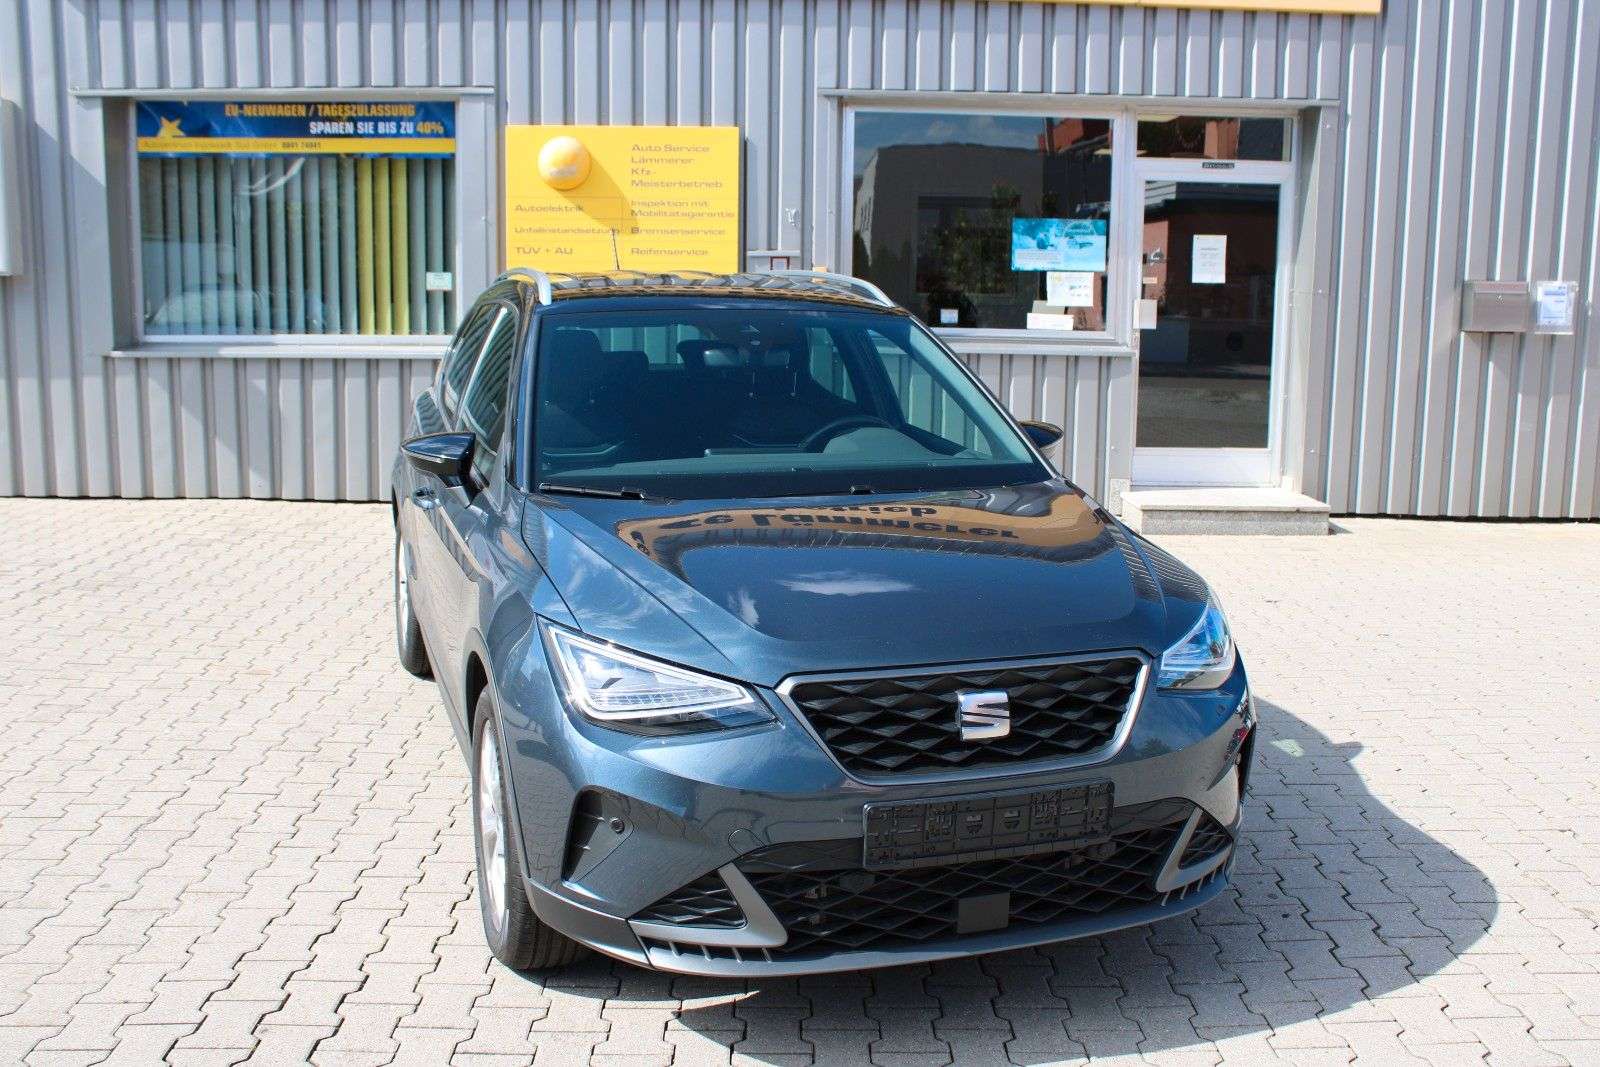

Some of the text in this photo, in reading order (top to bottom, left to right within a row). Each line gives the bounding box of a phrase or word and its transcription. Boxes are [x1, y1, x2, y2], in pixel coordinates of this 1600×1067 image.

[224, 103, 306, 117] EU-NEUWAGEN
[318, 103, 416, 117] TAGESZULASSUNG
[309, 121, 444, 135] SPAREN SIE BIS ZU 40%
[631, 144, 710, 153] Auto Service
[631, 180, 723, 189] Meisterbetrieb
[515, 204, 584, 213] Autoelektrik
[631, 200, 689, 208] Inspektion
[631, 227, 726, 235] Bremsenservice
[555, 247, 573, 255] AU
[631, 247, 709, 256] Reifenservice
